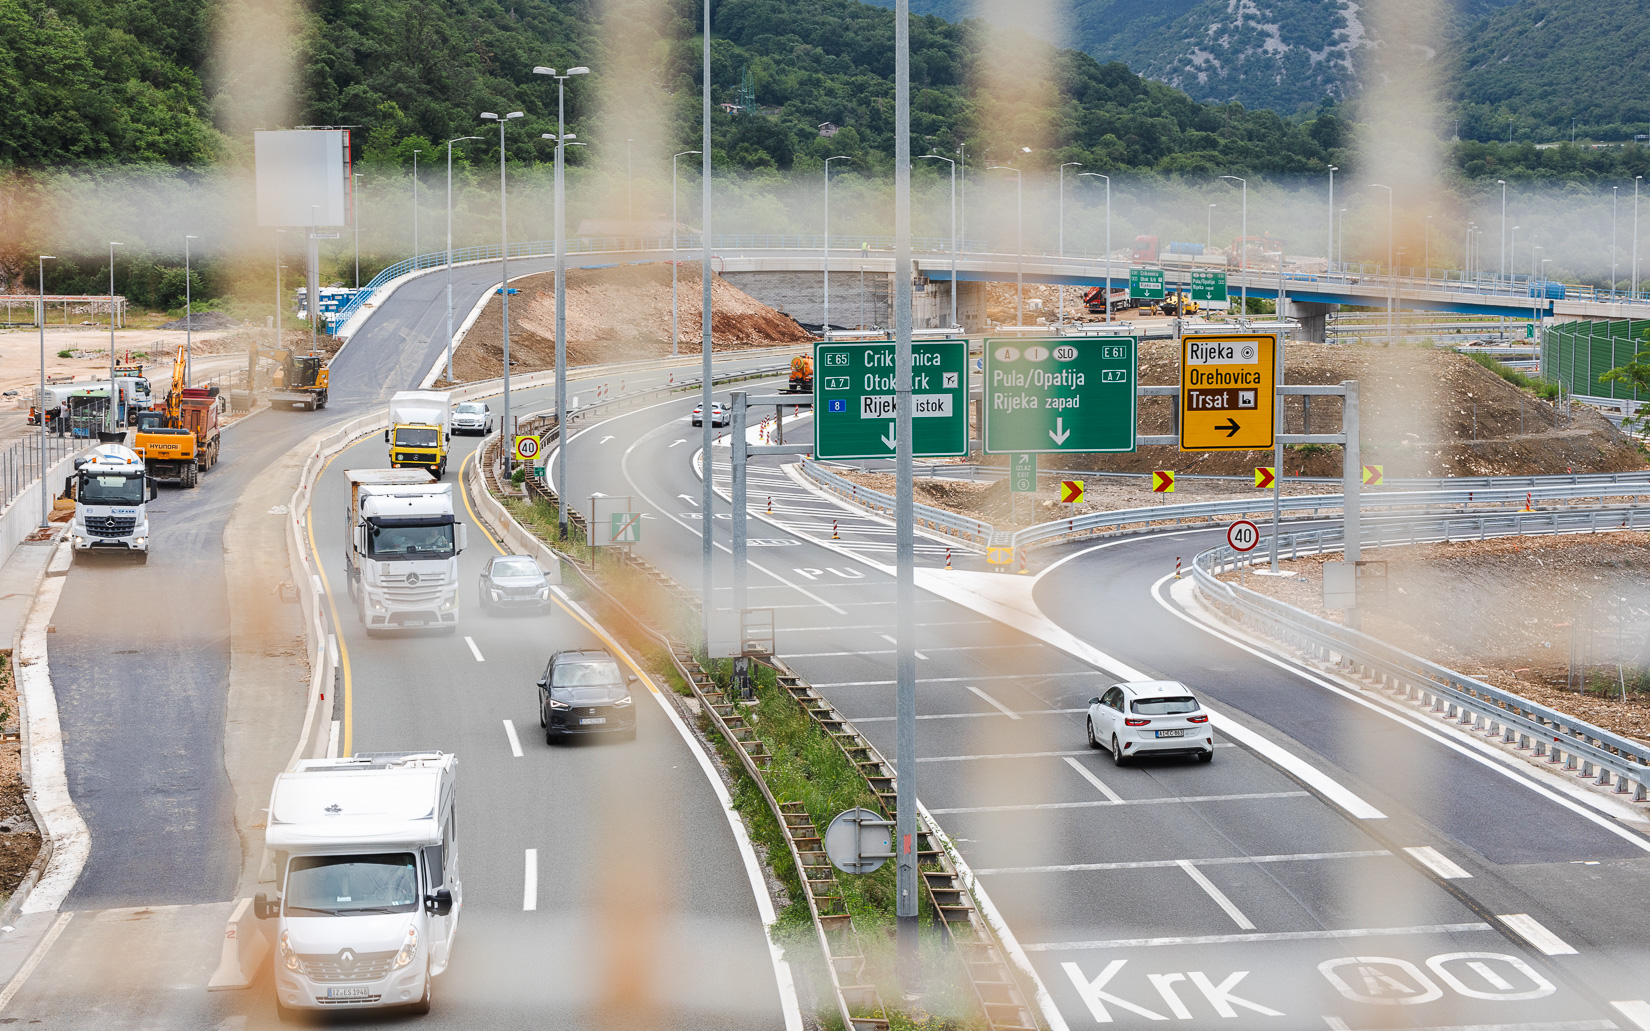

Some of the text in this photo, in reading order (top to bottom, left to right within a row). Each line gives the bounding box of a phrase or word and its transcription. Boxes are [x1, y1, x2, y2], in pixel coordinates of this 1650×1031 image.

[827, 354, 847, 365] E 65
[864, 350, 941, 367] Criknica
[1004, 349, 1011, 359] A
[1057, 348, 1074, 359] SLO
[1104, 347, 1123, 358] E 61
[1190, 342, 1234, 364] Rijeka
[830, 378, 845, 388] A 7
[994, 368, 1085, 390] Pula/Opatija
[1107, 371, 1121, 381] A 7
[1190, 368, 1261, 386] Orehovica
[834, 402, 840, 411] 8
[864, 396, 944, 417] Rijek istok
[994, 392, 1080, 414] Rijeka zapad
[1190, 391, 1229, 408] Trsat
[521, 442, 535, 453] 40
[1234, 528, 1252, 543] 40
[792, 567, 866, 580] PU
[1357, 965, 1417, 996] A
[1465, 961, 1516, 991] I
[1060, 958, 1288, 1023] Krk
